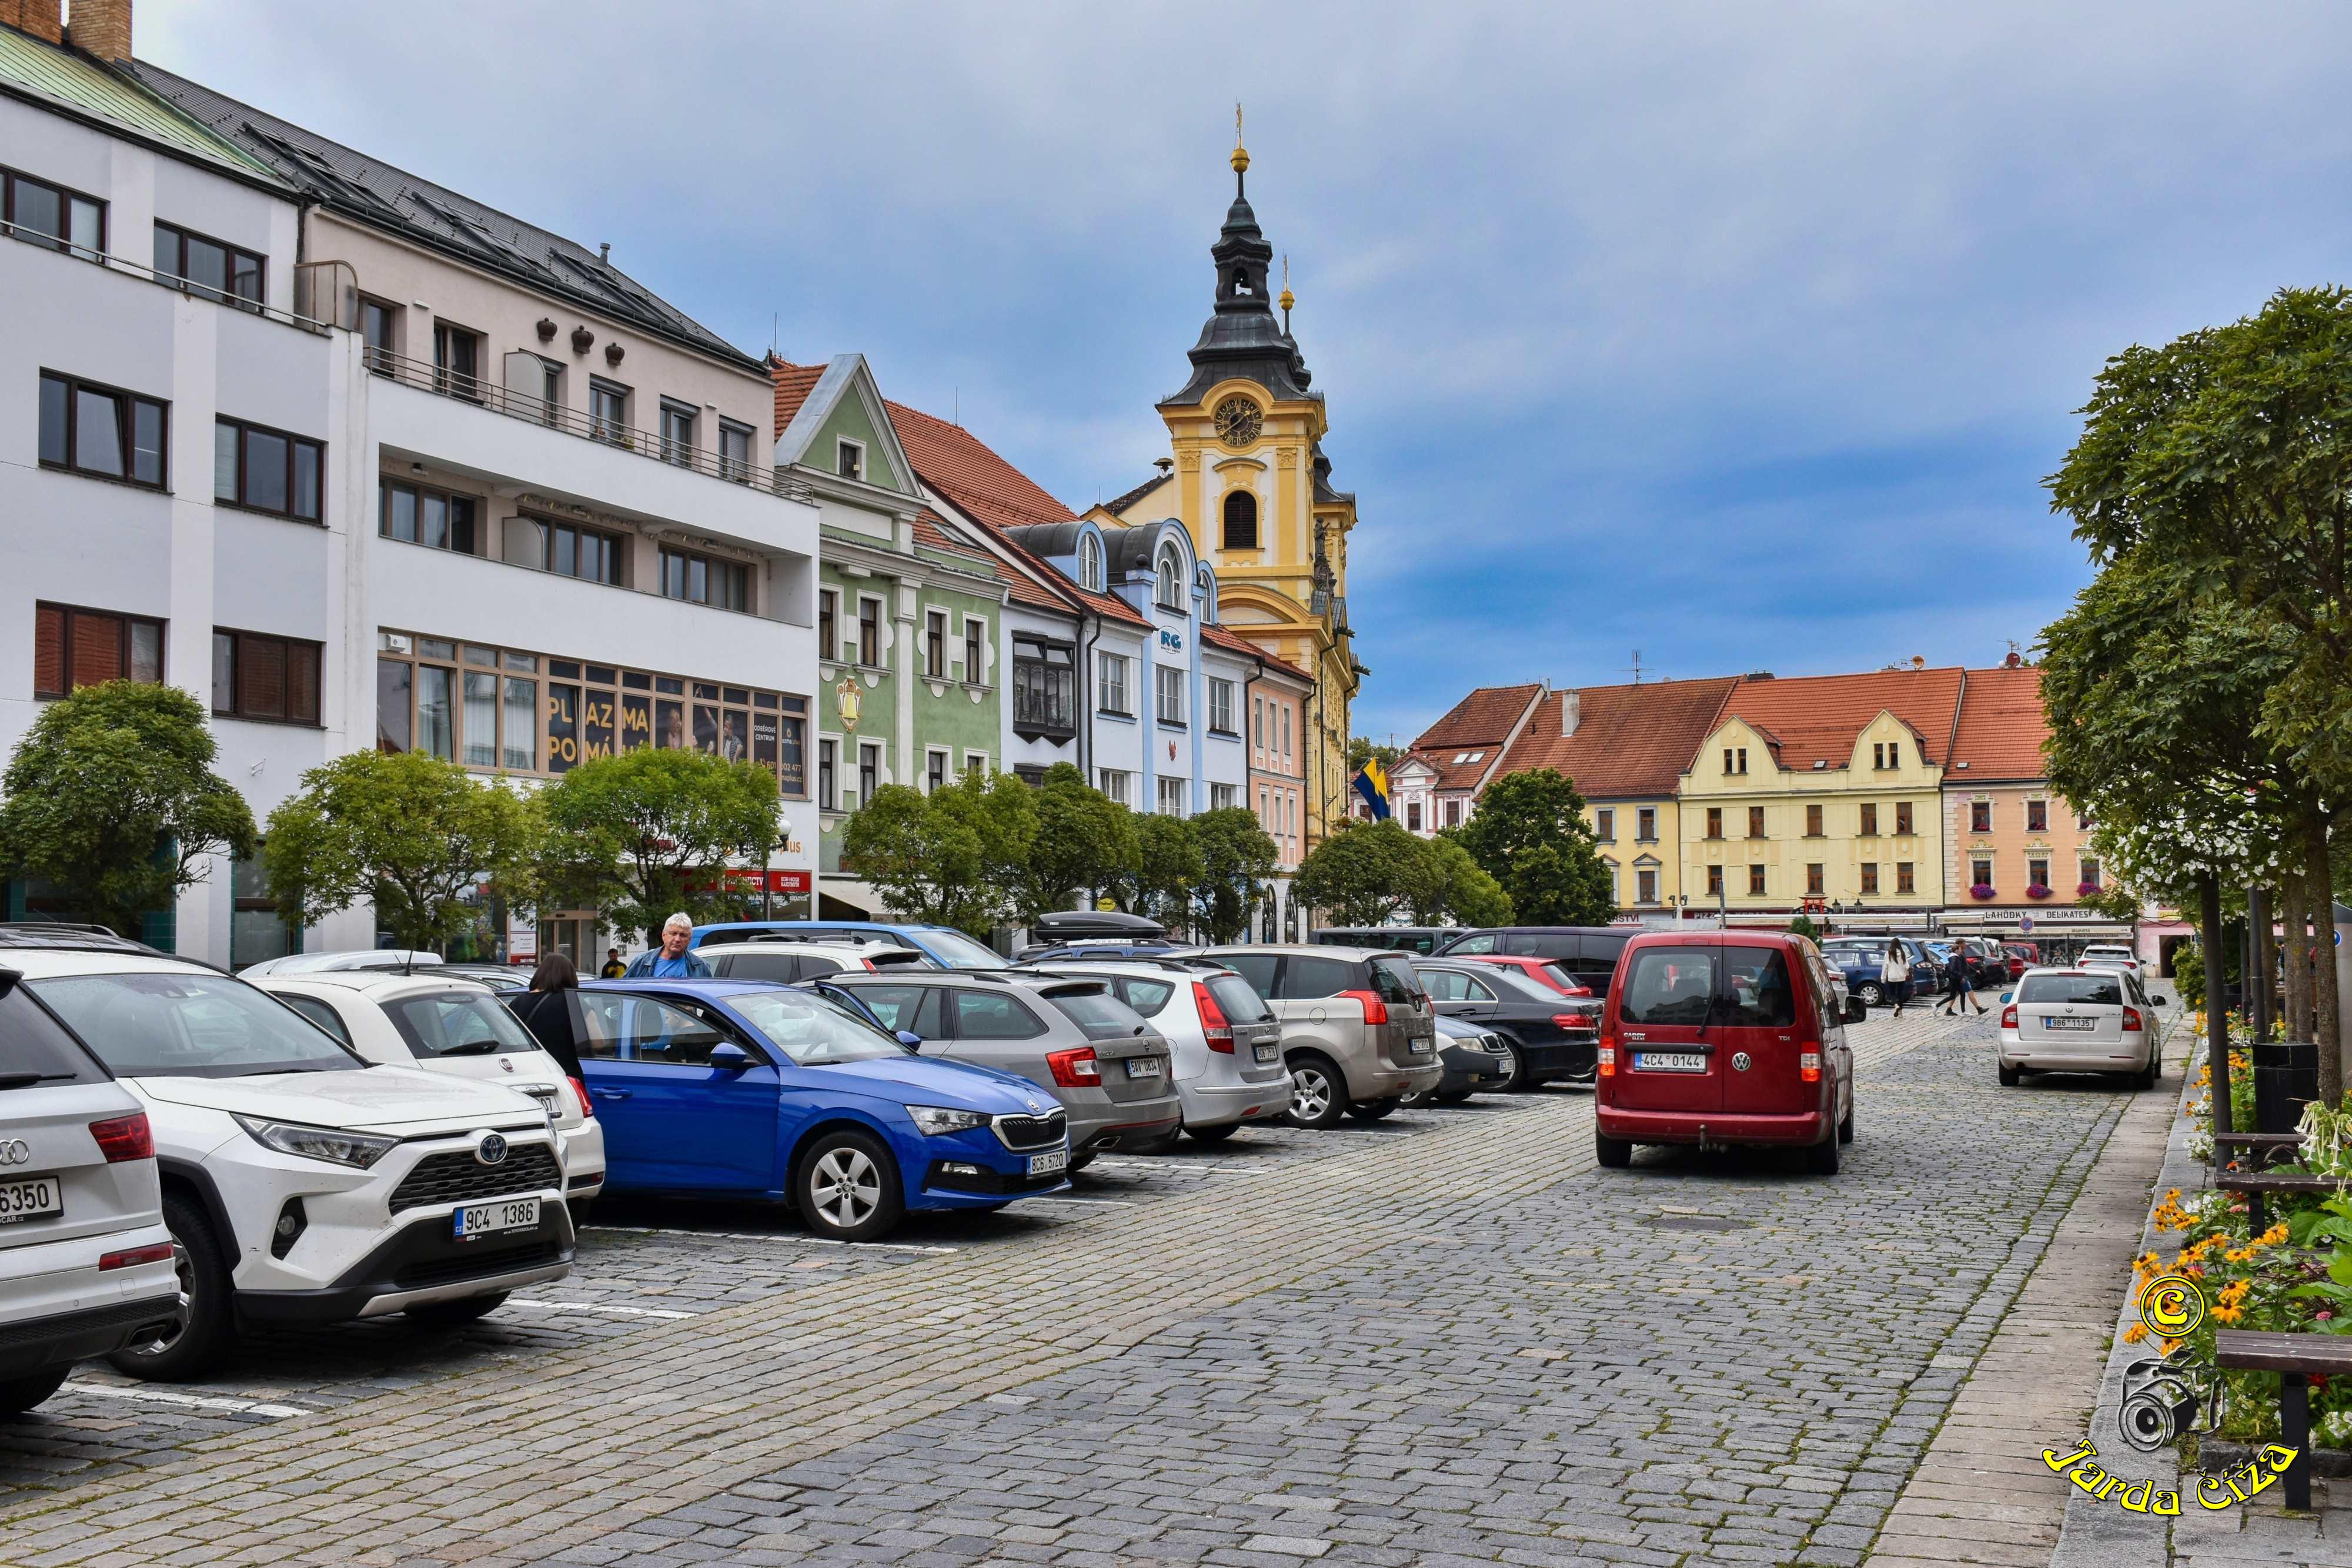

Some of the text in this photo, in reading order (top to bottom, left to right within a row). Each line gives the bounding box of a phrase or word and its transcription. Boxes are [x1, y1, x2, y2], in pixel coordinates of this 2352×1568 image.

[1161, 630, 1181, 650] RG
[549, 735, 643, 763] POMÁ
[1985, 910, 2027, 918] LAHŮDKY
[1131, 1059, 1157, 1073] 5AV 0834
[1644, 1055, 1700, 1067] 4C4 0144
[1032, 1153, 1063, 1172] 8C6 5720
[0, 1183, 49, 1212] 6350
[466, 1202, 533, 1231] 9C4 1386
